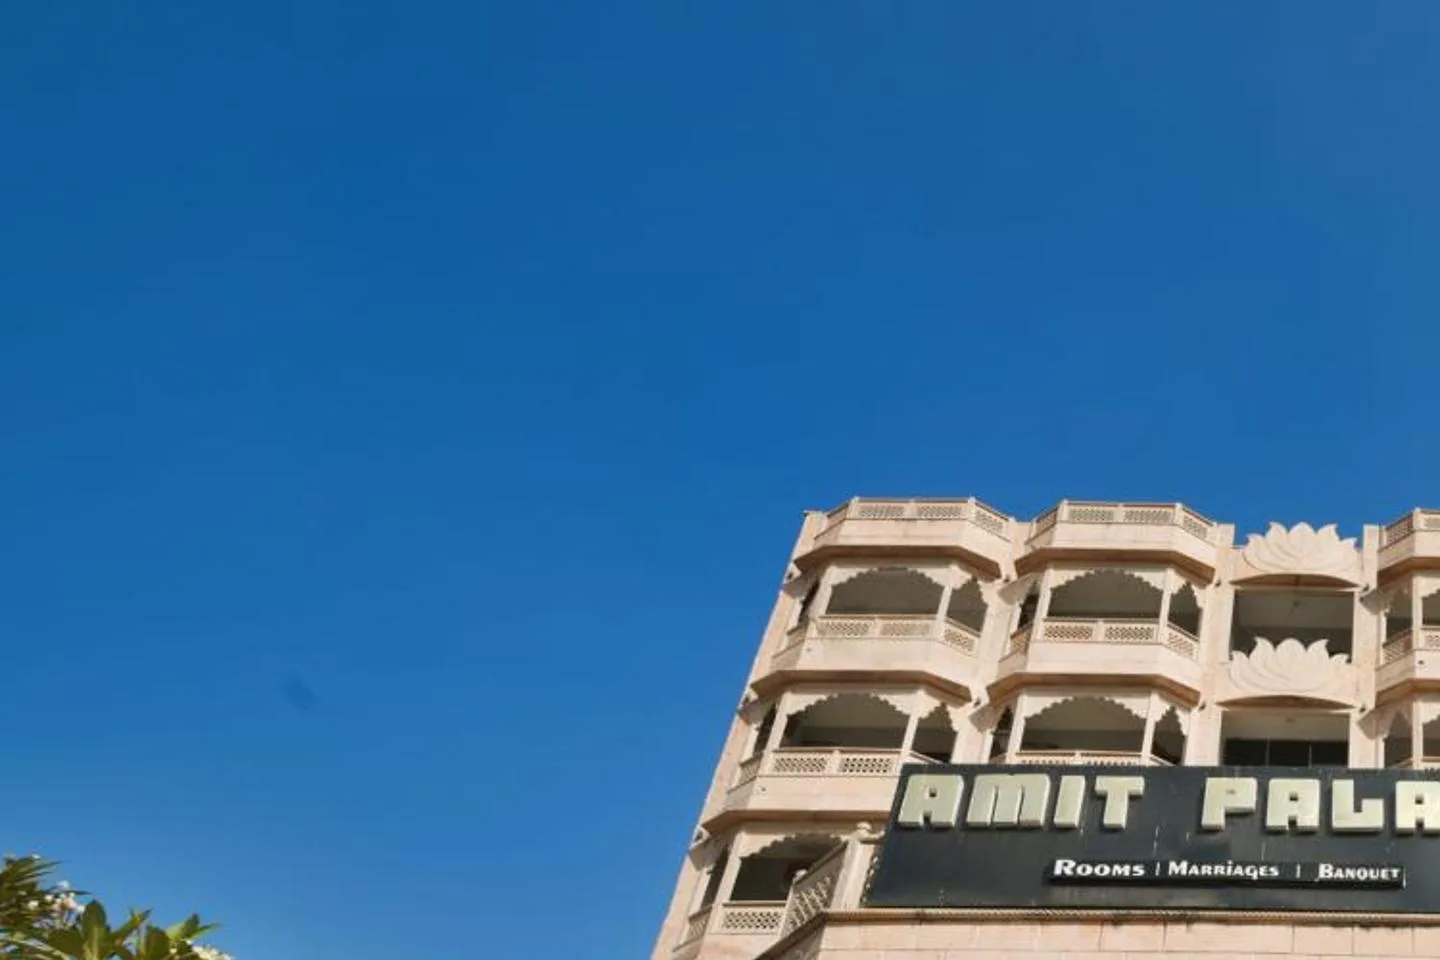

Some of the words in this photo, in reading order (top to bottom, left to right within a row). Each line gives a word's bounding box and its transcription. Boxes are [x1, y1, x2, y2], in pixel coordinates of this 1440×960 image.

[898, 773, 1146, 829] AMIT
[1053, 858, 1146, 877] ROOMS
[1318, 863, 1402, 882] BANQUET
